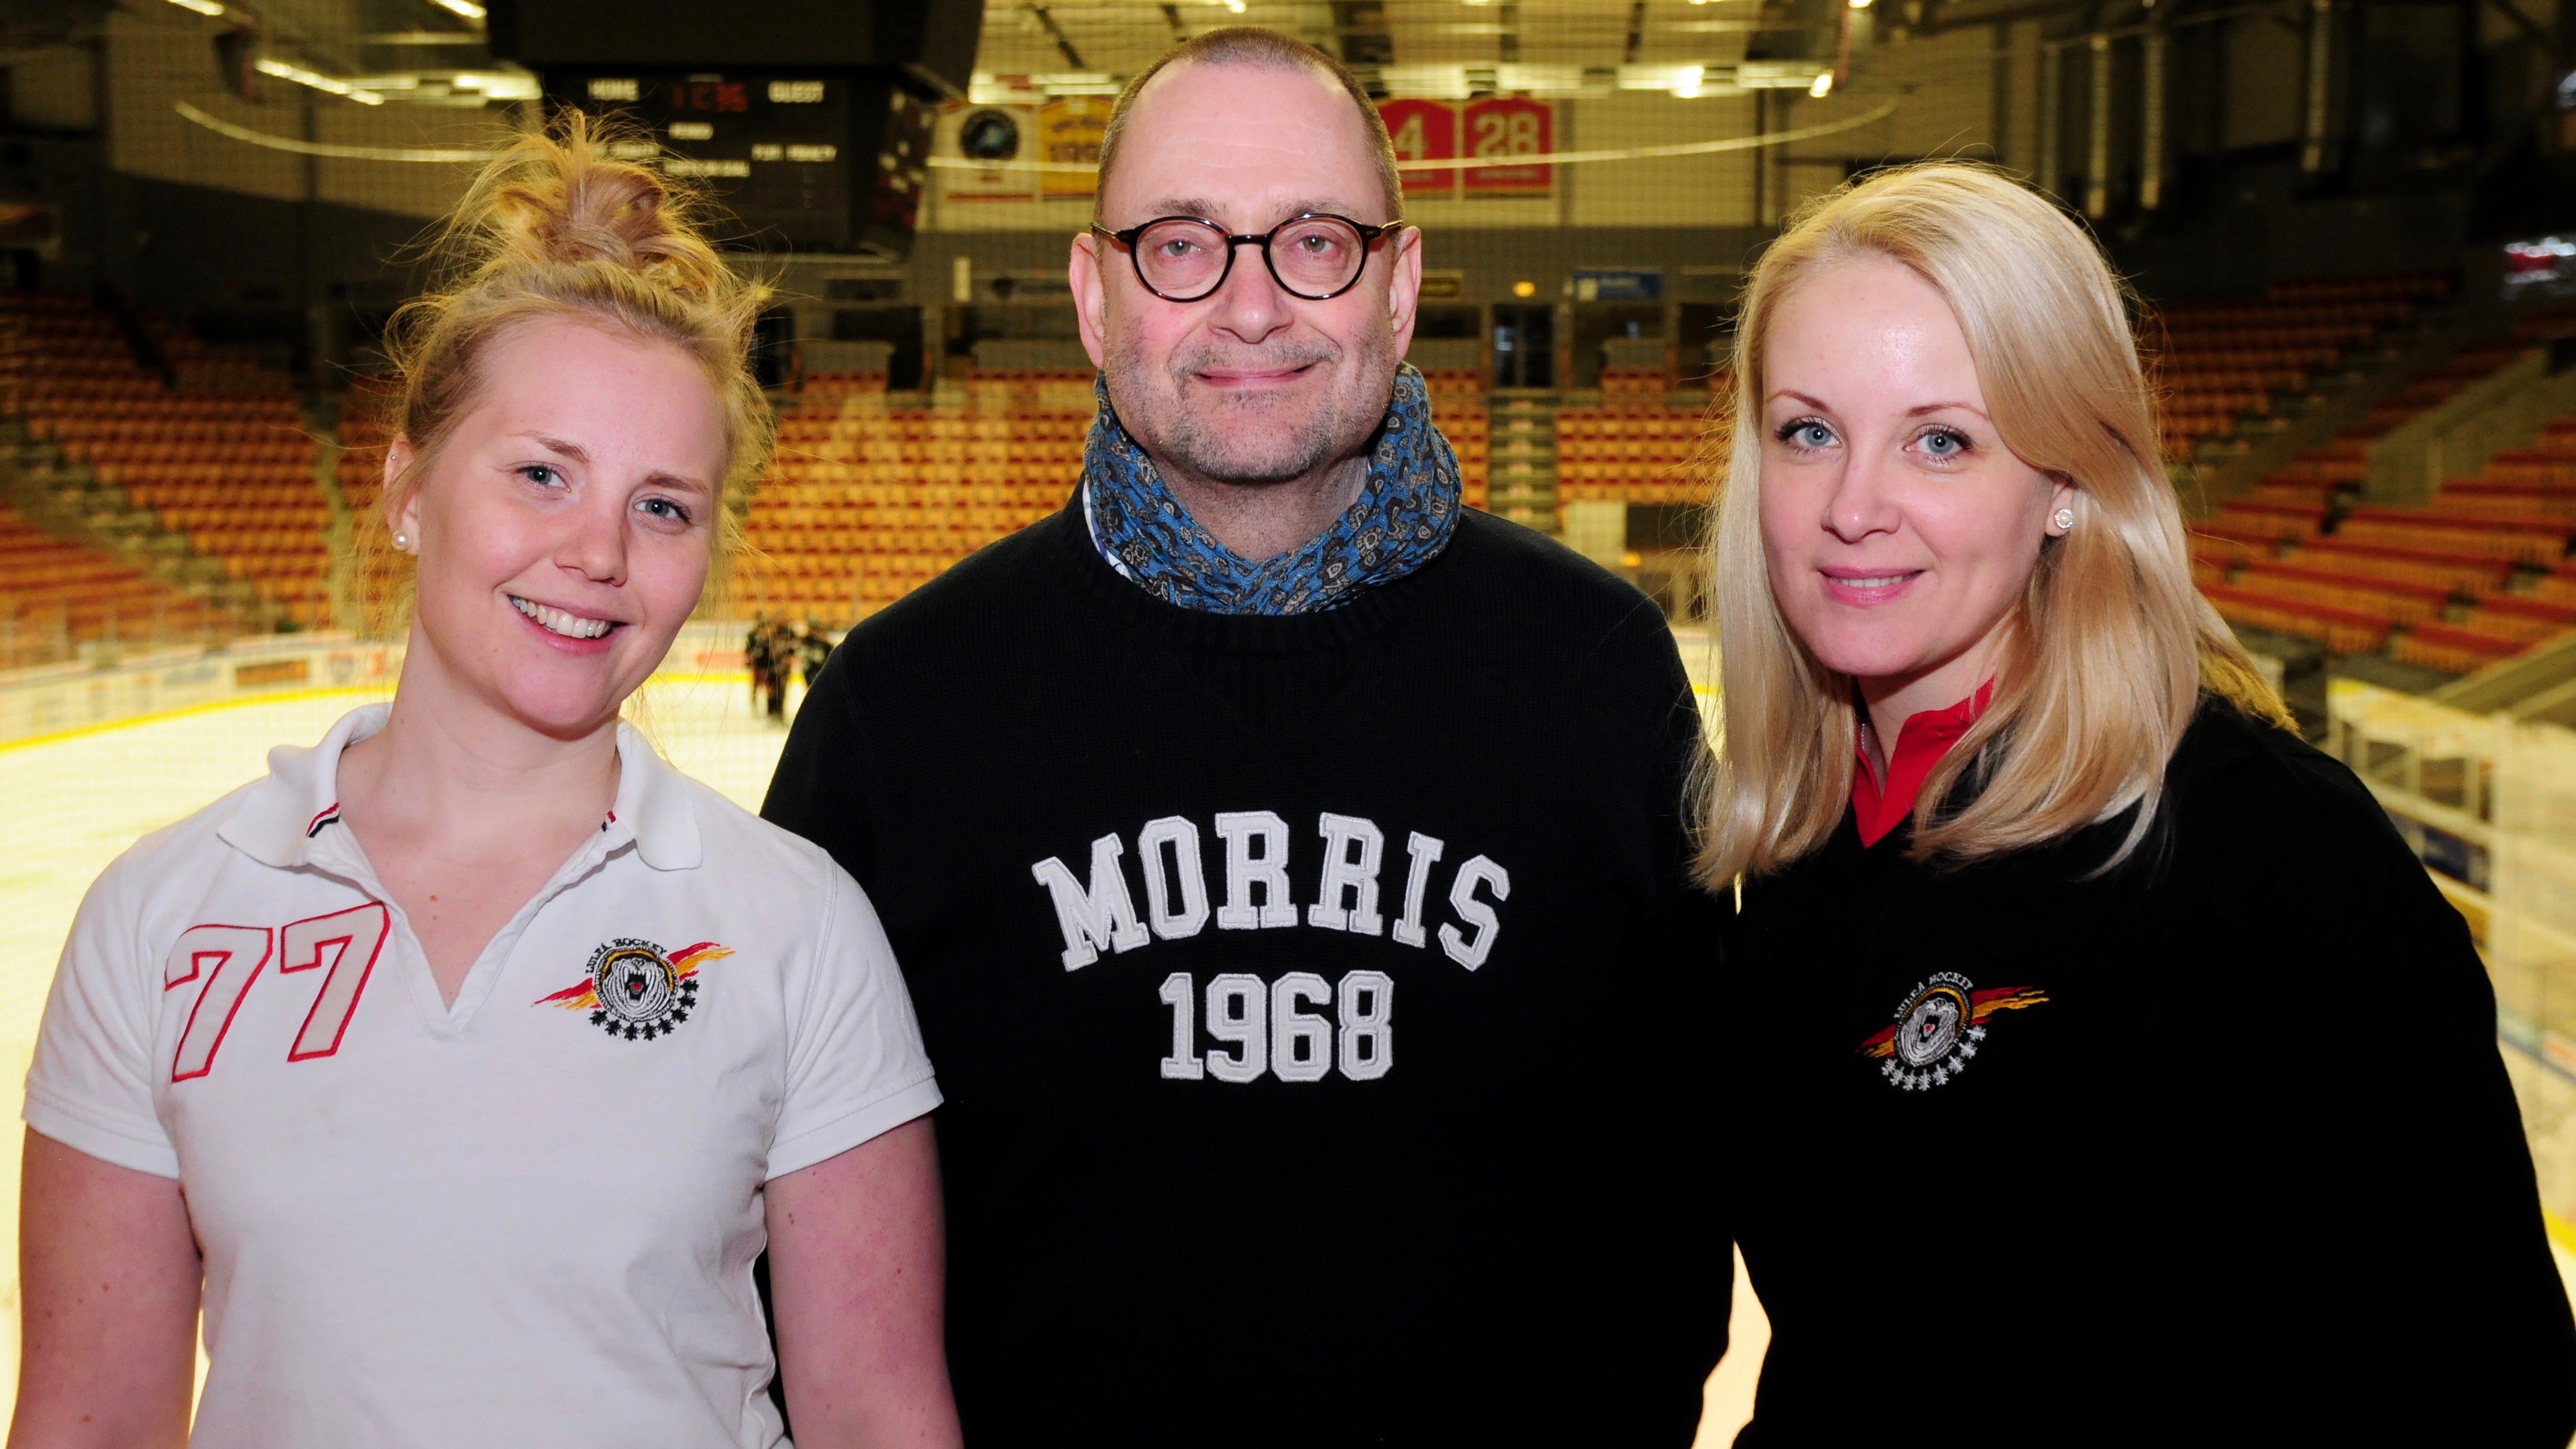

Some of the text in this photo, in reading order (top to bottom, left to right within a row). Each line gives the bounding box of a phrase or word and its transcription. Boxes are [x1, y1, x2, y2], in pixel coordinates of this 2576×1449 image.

[768, 80, 824, 103] GUEST
[1475, 113, 1539, 159] 28
[1031, 811, 1510, 971] MORRIS
[612, 938, 667, 955] HOCKEY
[165, 900, 390, 1084] 77
[1928, 971, 1973, 991] HOCKEY
[1159, 971, 1394, 1083] 1968
